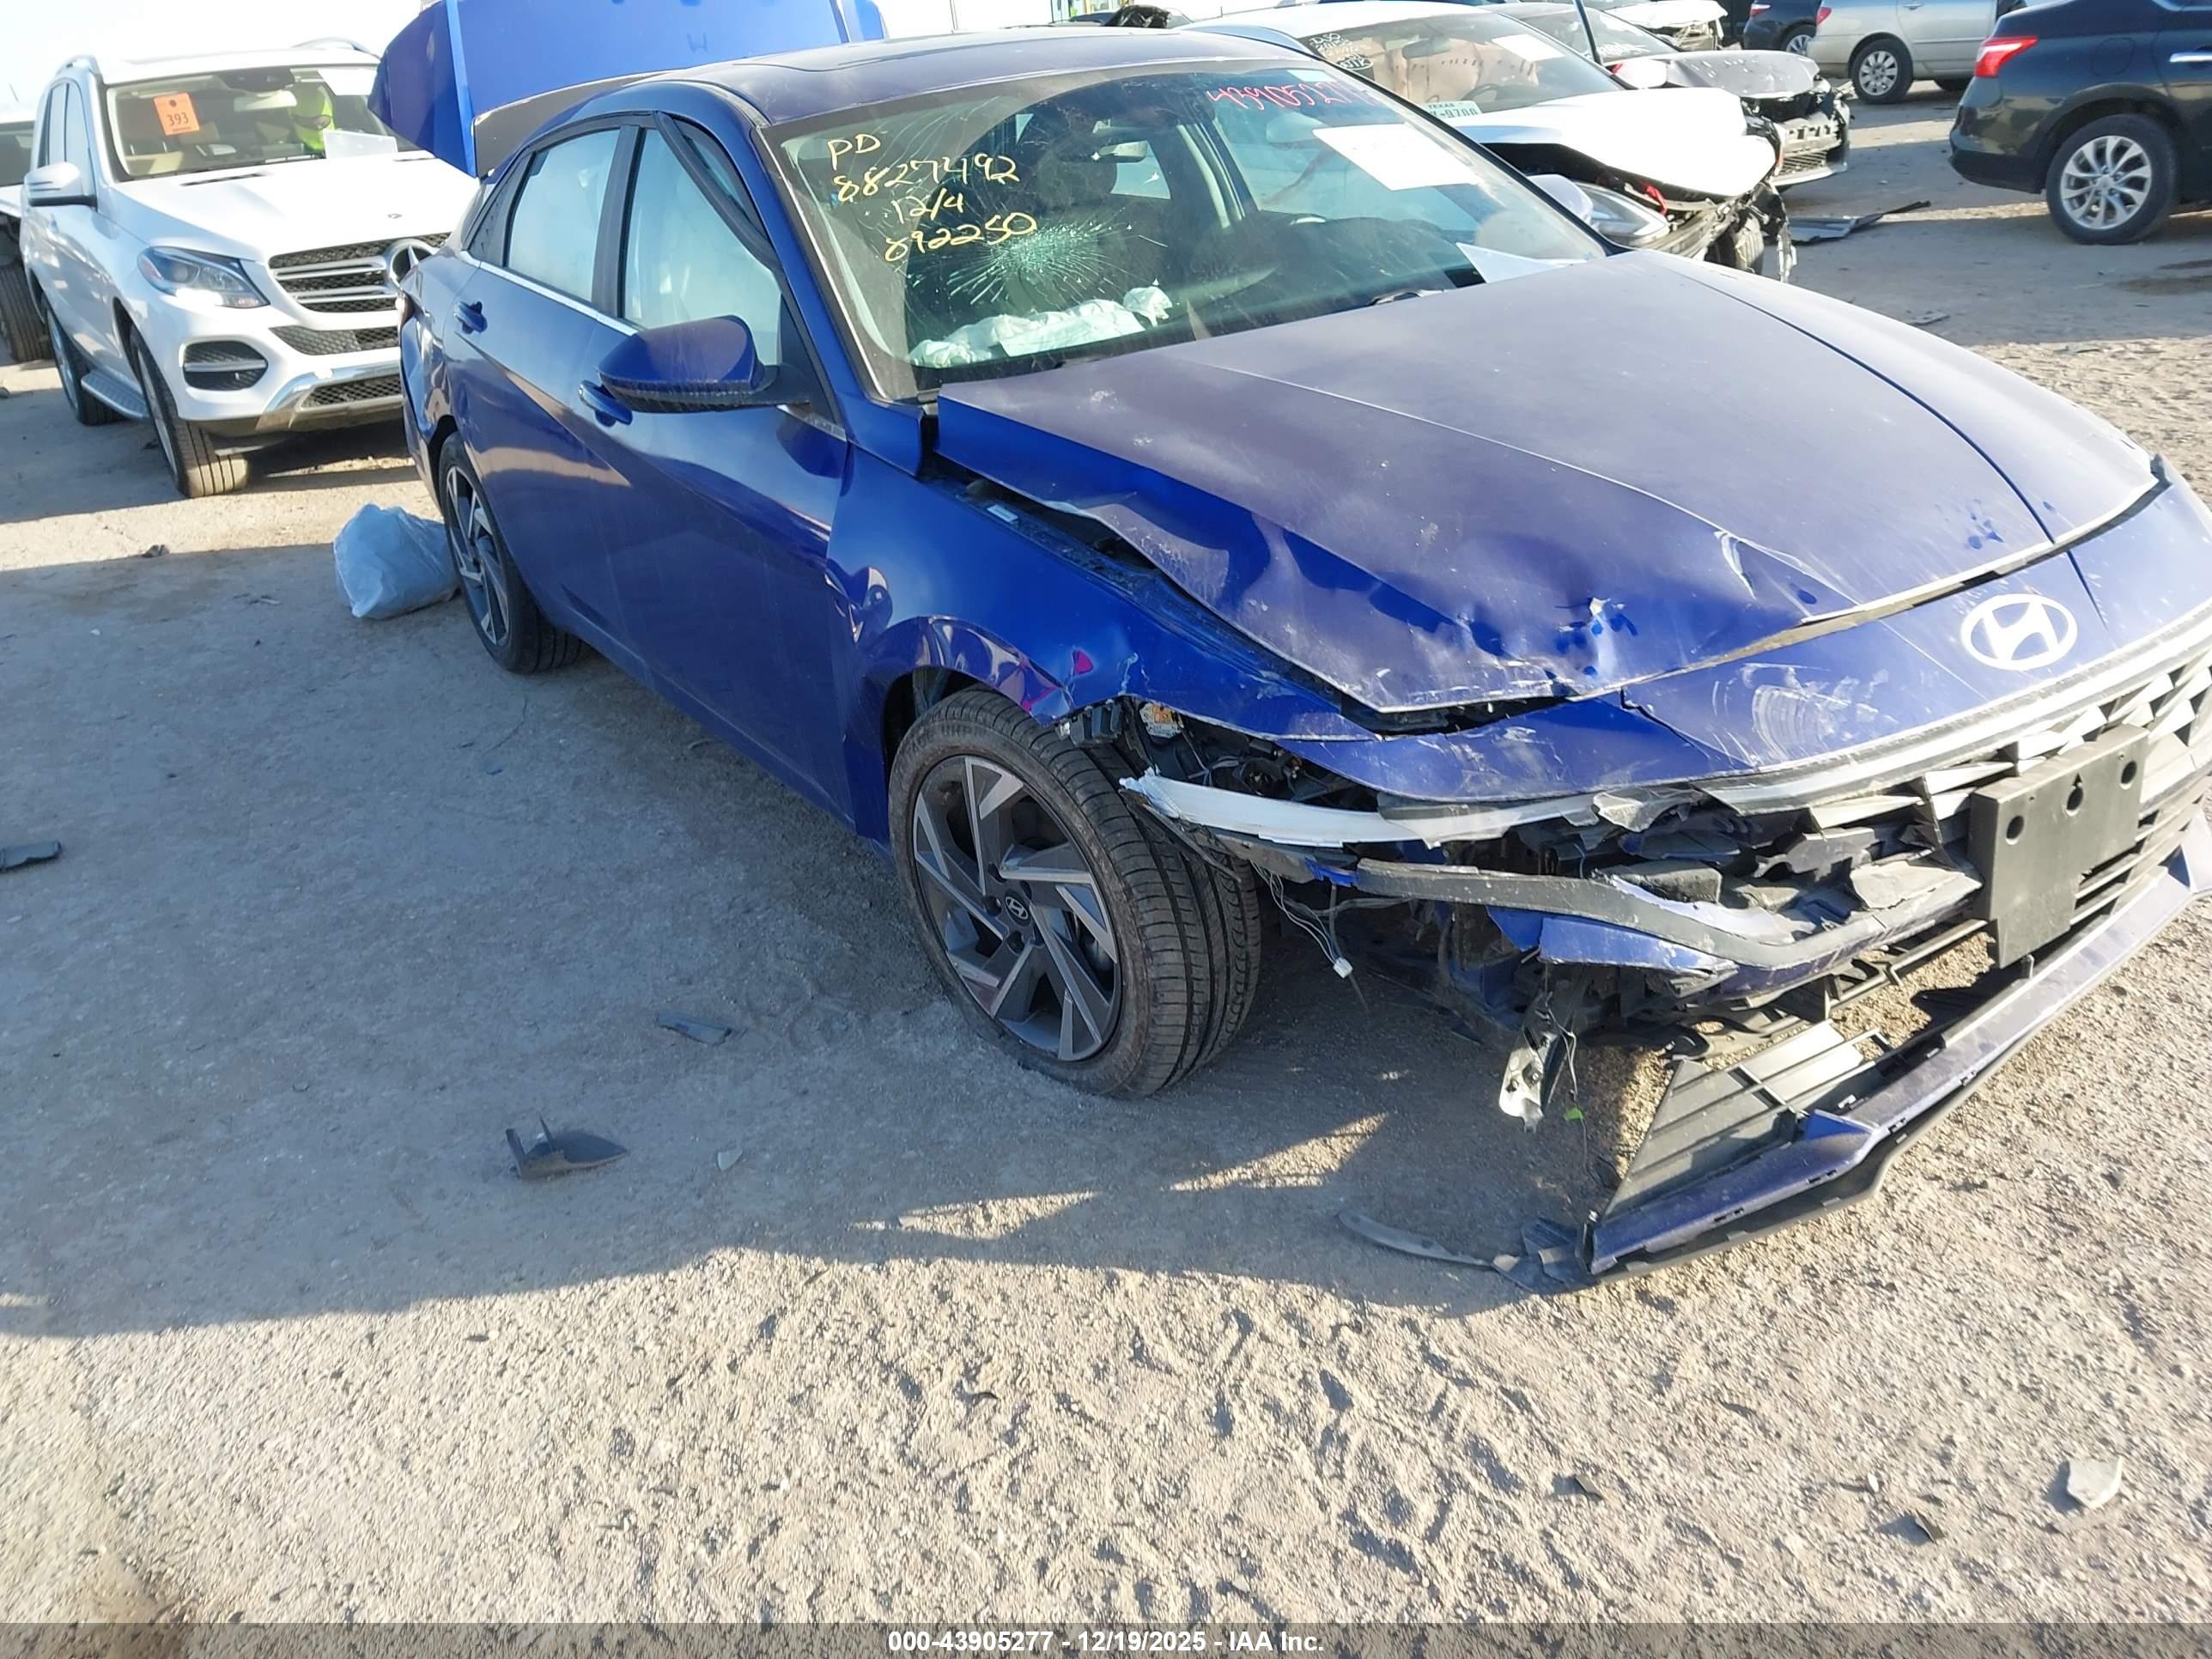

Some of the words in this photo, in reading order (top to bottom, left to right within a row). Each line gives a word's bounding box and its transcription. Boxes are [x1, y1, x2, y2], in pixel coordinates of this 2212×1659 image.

[166, 112, 189, 126] 393
[827, 133, 881, 171] PD
[833, 153, 1020, 203] 8827492
